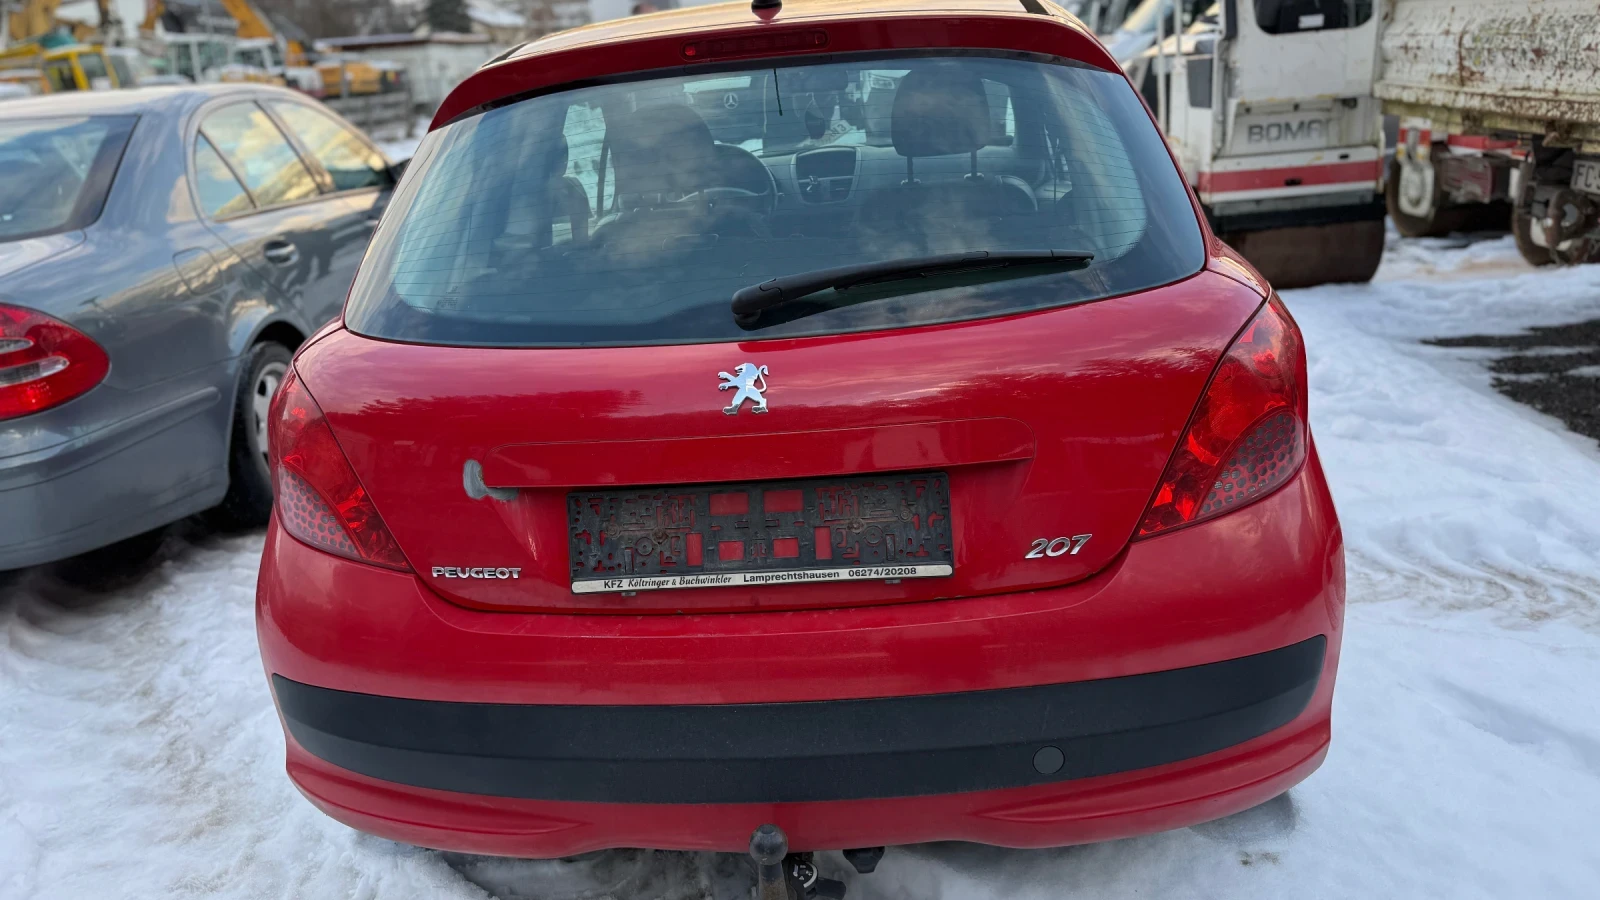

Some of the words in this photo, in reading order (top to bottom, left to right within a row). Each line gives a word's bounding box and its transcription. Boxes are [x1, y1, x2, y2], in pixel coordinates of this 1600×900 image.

[1024, 533, 1093, 559] 207
[431, 566, 522, 579] PEUGEOT
[603, 579, 624, 589] KFZ
[627, 577, 670, 588] Költringer
[671, 578, 677, 586] &
[678, 575, 732, 586] Buchwinkler
[743, 571, 840, 583] Lamprechtshausen
[848, 567, 917, 578] 06274/20208
